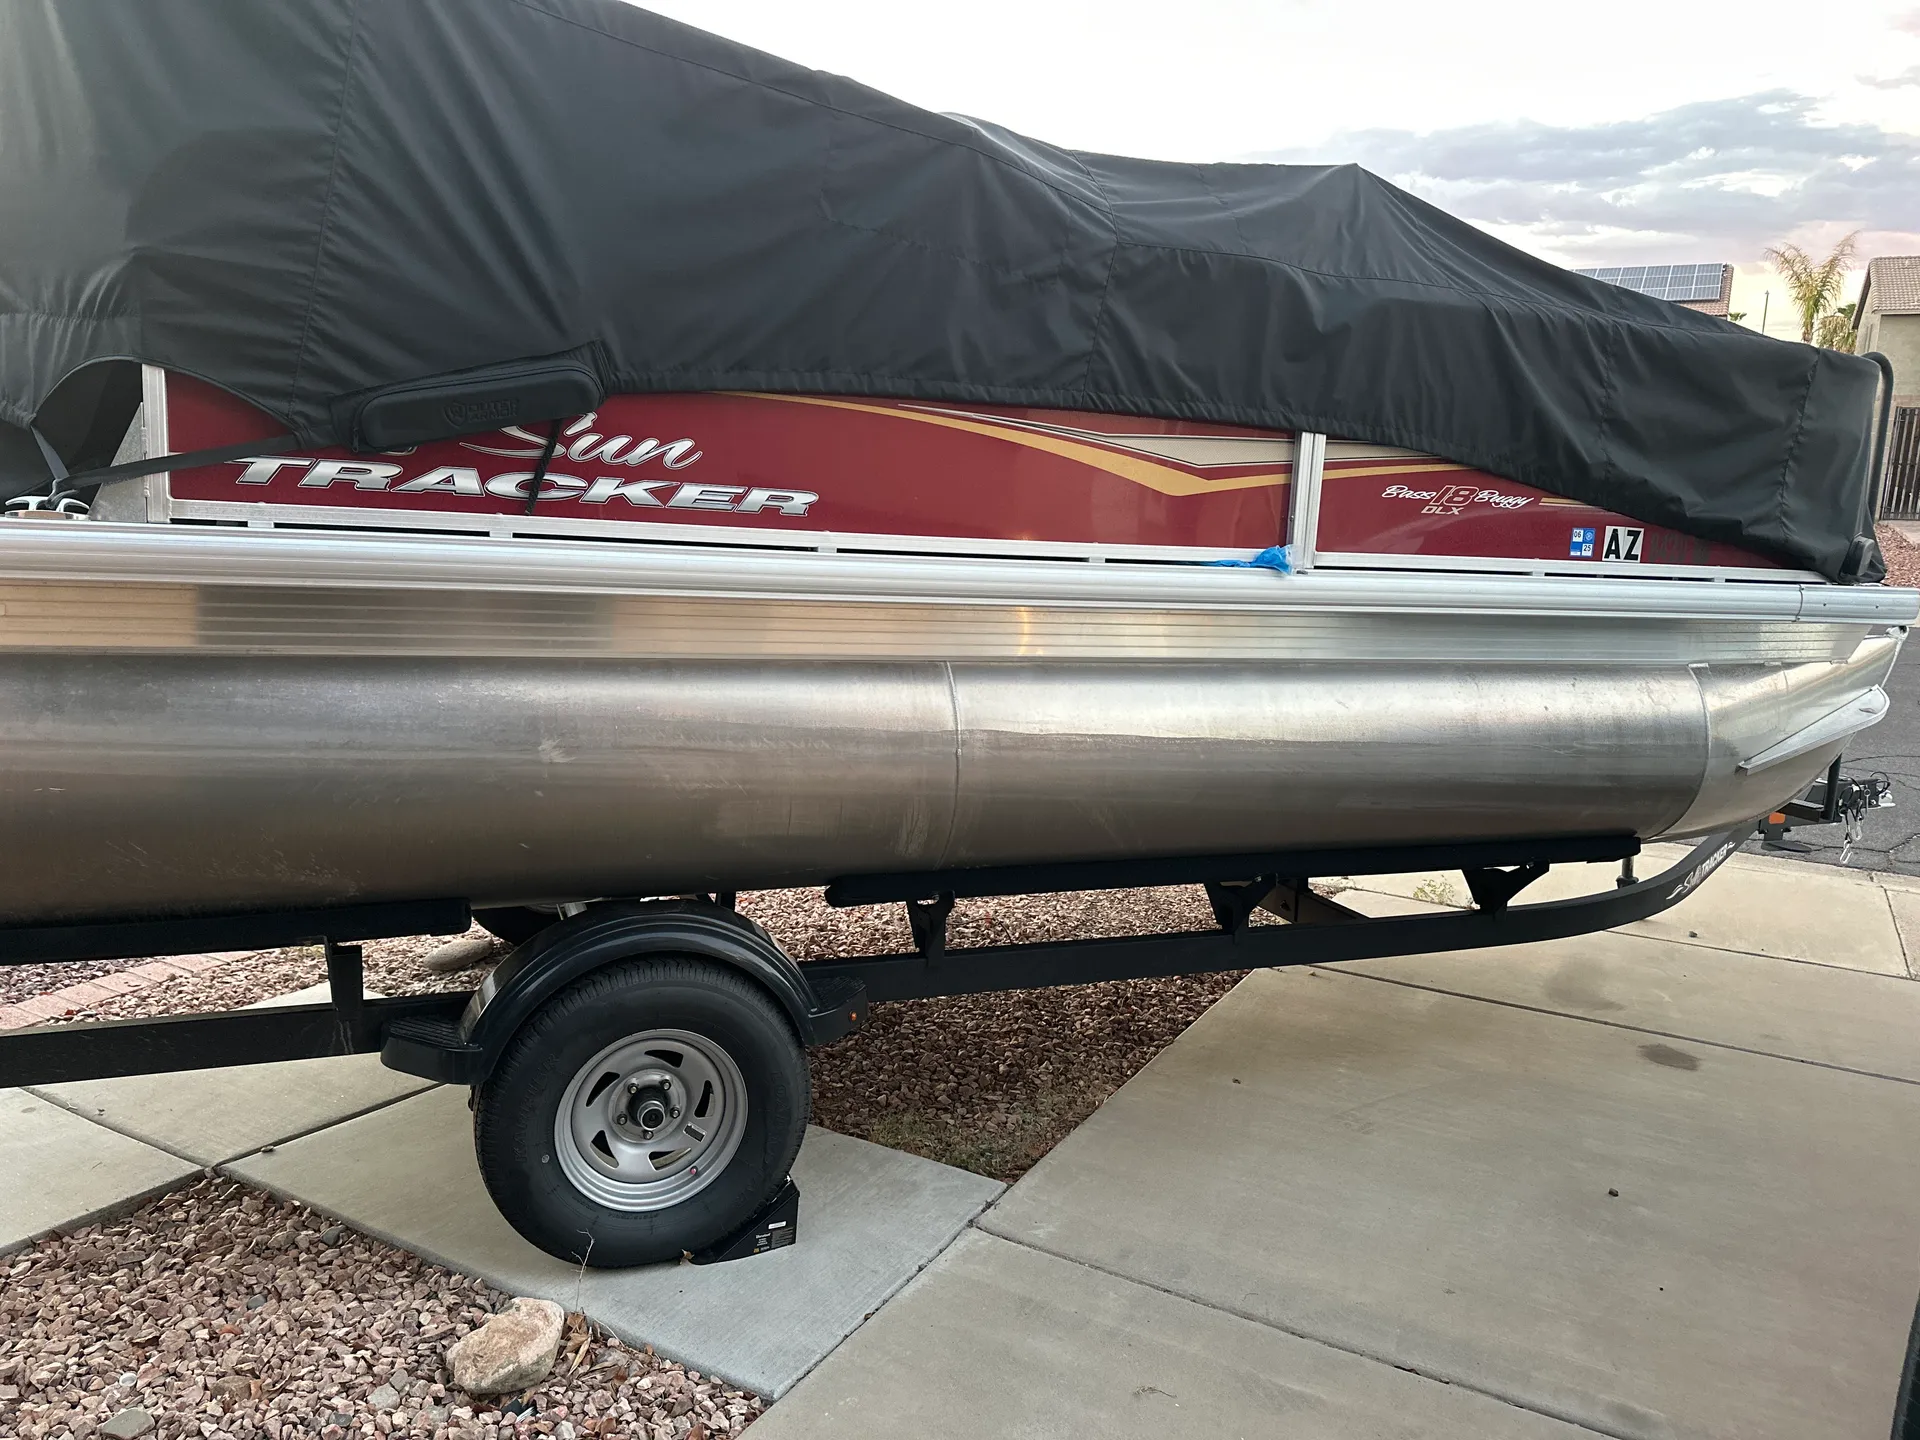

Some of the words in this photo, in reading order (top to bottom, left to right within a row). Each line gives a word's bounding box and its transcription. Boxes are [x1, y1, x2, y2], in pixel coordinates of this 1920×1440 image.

[460, 412, 703, 470] Sun
[227, 455, 818, 517] TRACKER
[1381, 485, 1437, 500] Bass
[1429, 484, 1480, 506] 18
[1474, 490, 1534, 509] Buggy
[1421, 506, 1464, 515] DLX
[1604, 528, 1640, 561] AZ
[1701, 844, 1728, 875] TRACKER
